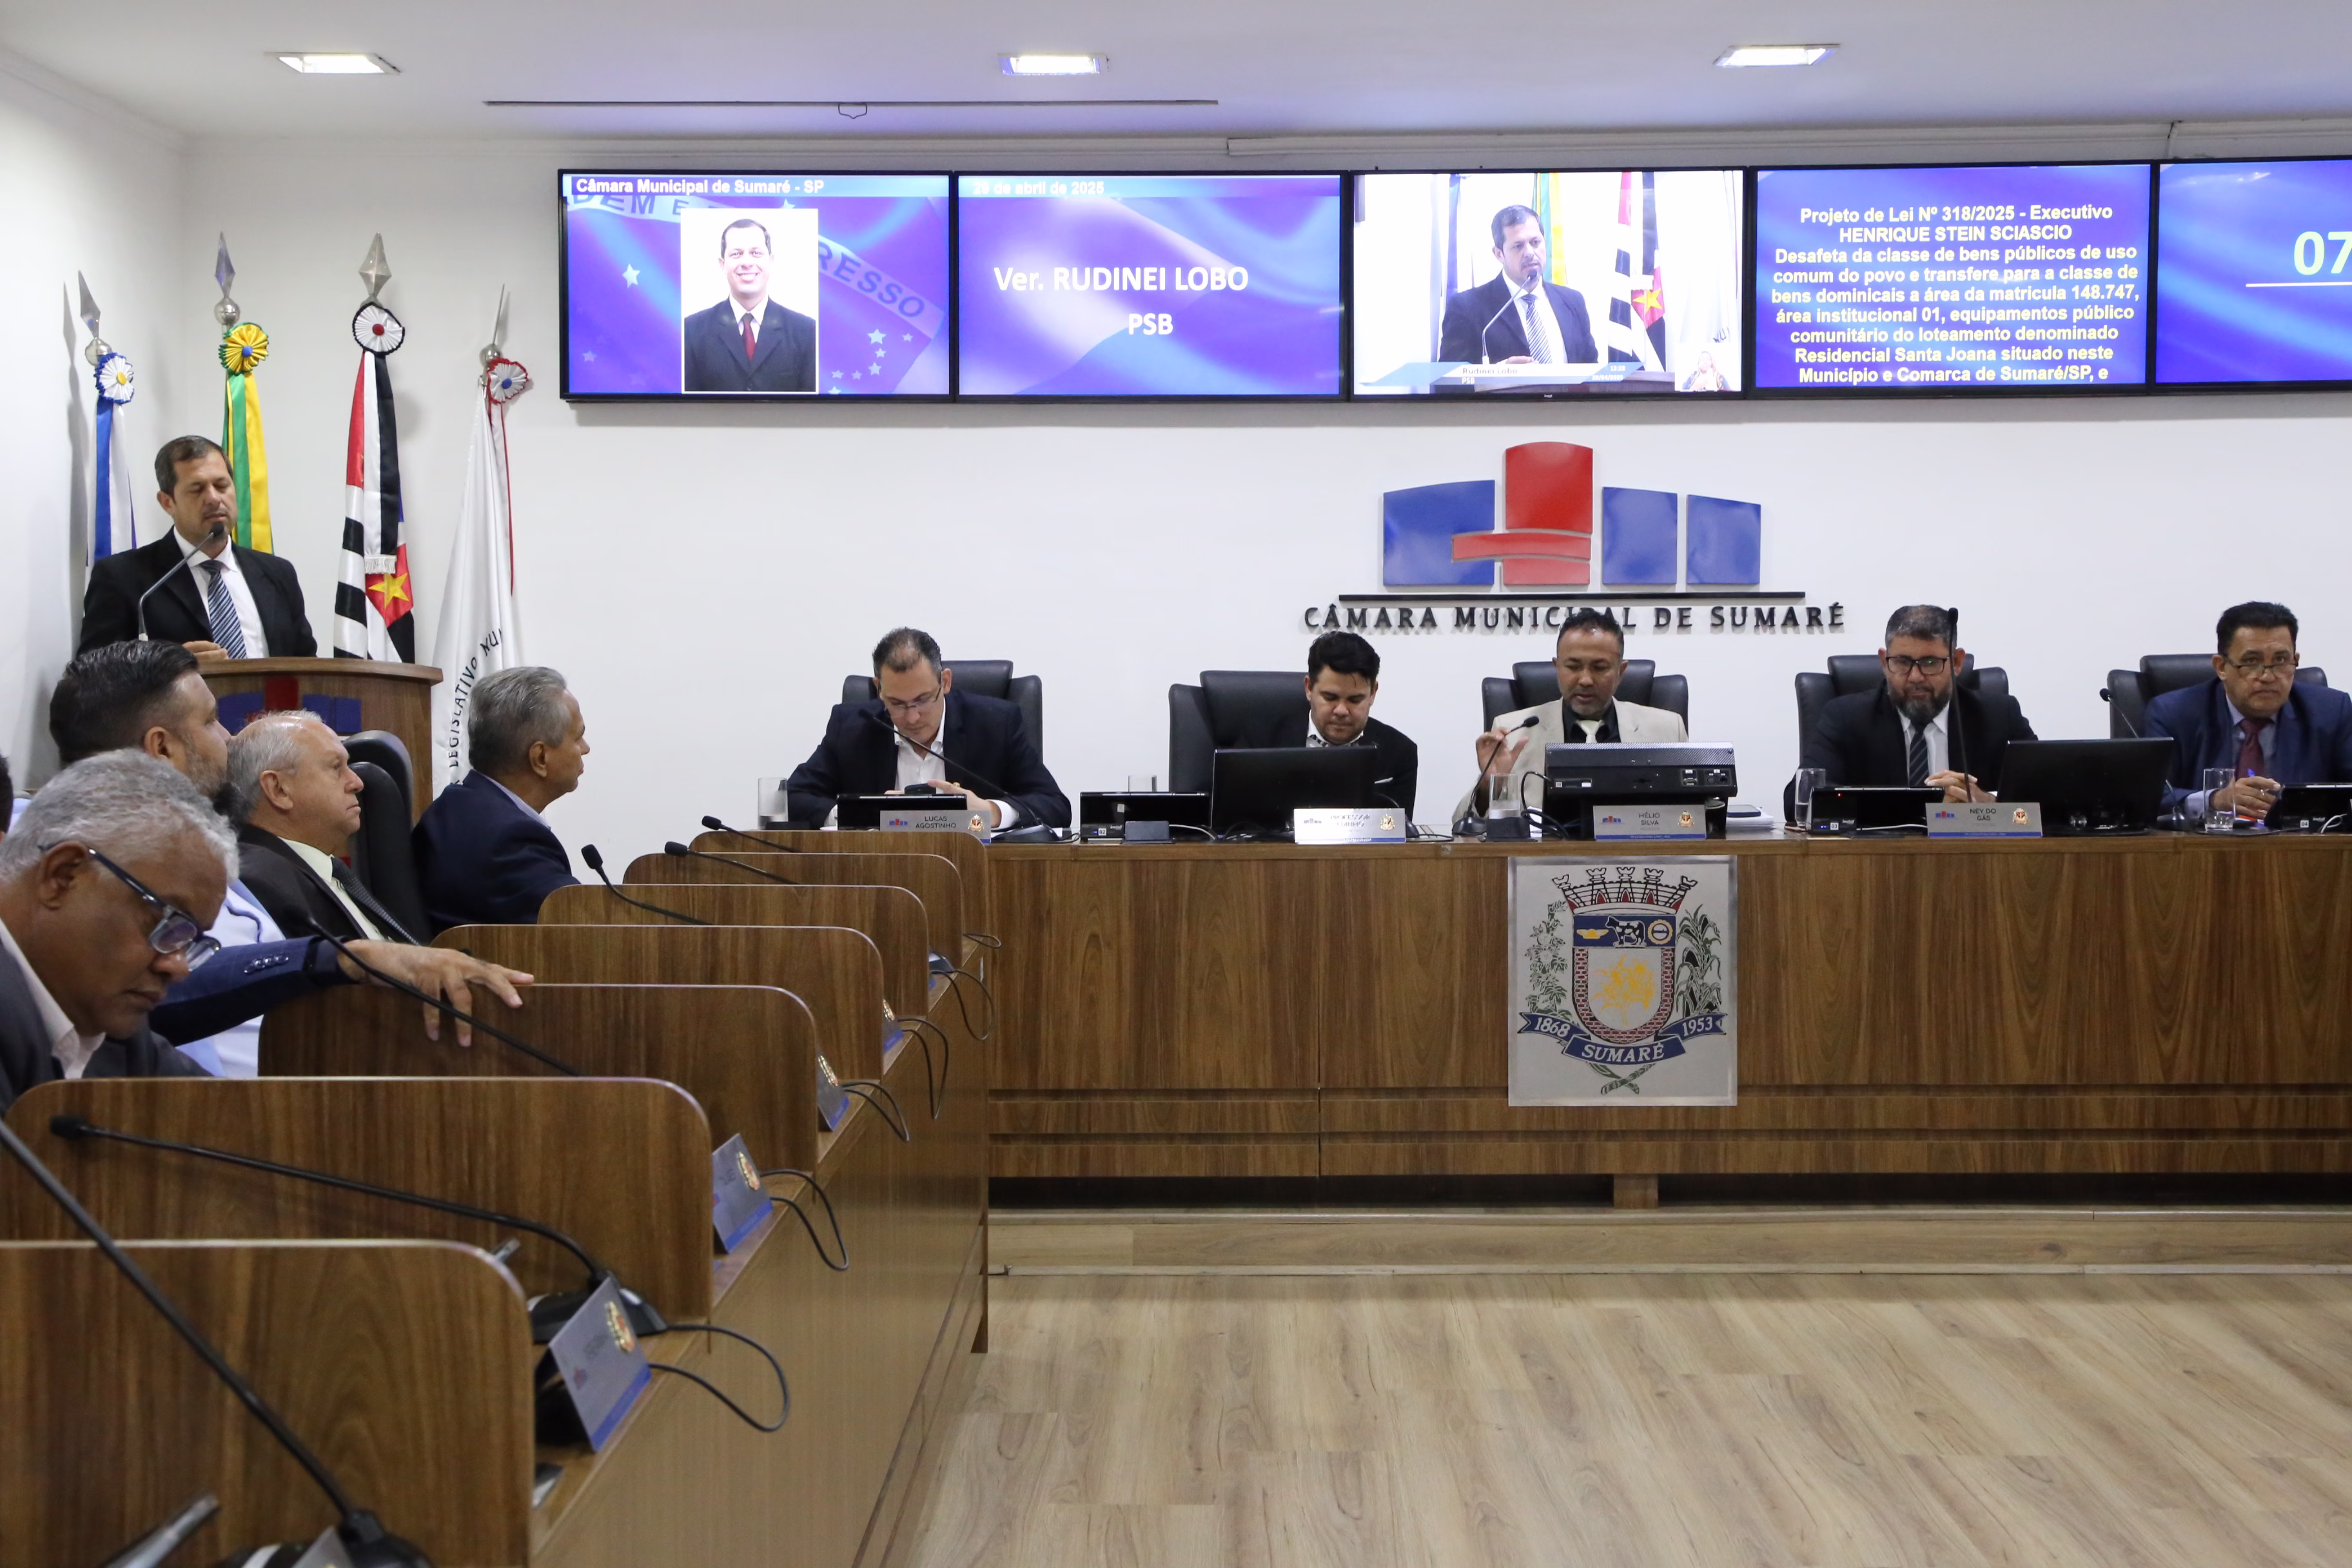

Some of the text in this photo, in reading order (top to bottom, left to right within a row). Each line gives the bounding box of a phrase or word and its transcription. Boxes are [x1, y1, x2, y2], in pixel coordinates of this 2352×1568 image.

[576, 179, 633, 193] Câmara
[637, 179, 708, 196] Municipal
[712, 179, 730, 193] de
[734, 179, 791, 193] Sumaré
[803, 179, 825, 193] SP
[994, 181, 1011, 194] de
[1015, 181, 1046, 194] abril
[1050, 181, 1068, 194] de
[1071, 181, 1104, 194] 2025
[1801, 208, 1859, 226] Projeto
[1864, 208, 1884, 222] de
[1889, 207, 1914, 222] Lei
[1918, 206, 1938, 222] Nº
[1942, 205, 2015, 221] 318/2025
[2030, 204, 2113, 220] Executivo
[1839, 224, 2072, 242] HENRIQUE STEIN SCIASCIO
[1776, 244, 2137, 264] Desafeta da classe de bens públicos de uso
[2294, 231, 2352, 275] 07
[994, 266, 1249, 291] Ver. RUDINEI LOBO
[1773, 264, 2139, 286] comum do povo e transfere para a classe de
[1772, 284, 2139, 303] bens dominicais a área da matricula 148.747,
[1128, 313, 1173, 335] PSB
[1776, 305, 2135, 324] área institucional 01, equipamentos público
[1790, 325, 2119, 343] comunitário do loteamento denominado
[1795, 346, 2113, 362] Residencial Santa Joana situado neste
[1799, 365, 2108, 386] Município e Comarca de Sumaré/SP, e
[1304, 603, 1438, 628] CÂMARA
[1653, 607, 1692, 627] DE
[1710, 602, 1845, 627] SUMARÉ
[448, 656, 478, 768] LEGISLATIVO
[1534, 1016, 1571, 1036] 1868
[1681, 1016, 1714, 1037] 1953
[1581, 1042, 1665, 1063] SUMARÉ
